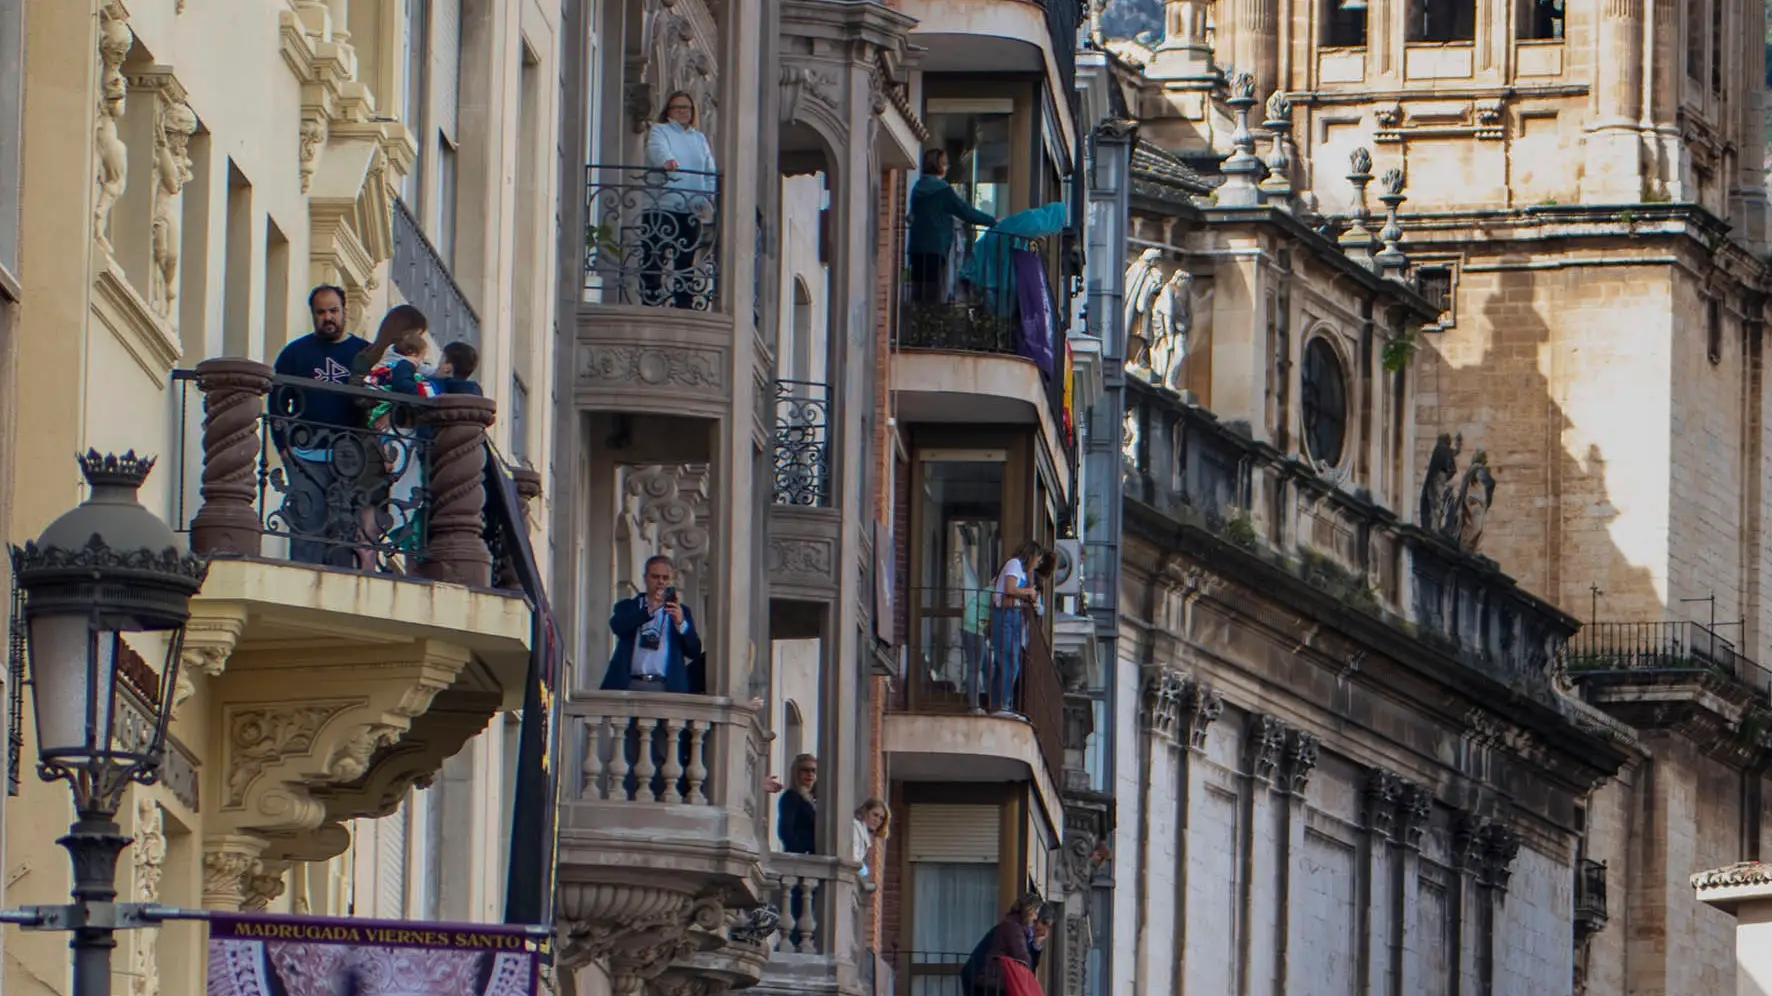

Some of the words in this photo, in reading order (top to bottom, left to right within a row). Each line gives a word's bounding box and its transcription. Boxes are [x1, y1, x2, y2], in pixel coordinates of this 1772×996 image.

[234, 922, 360, 942] MADRUGADA
[367, 928, 450, 946] VIERNES
[455, 932, 521, 949] SANTO
